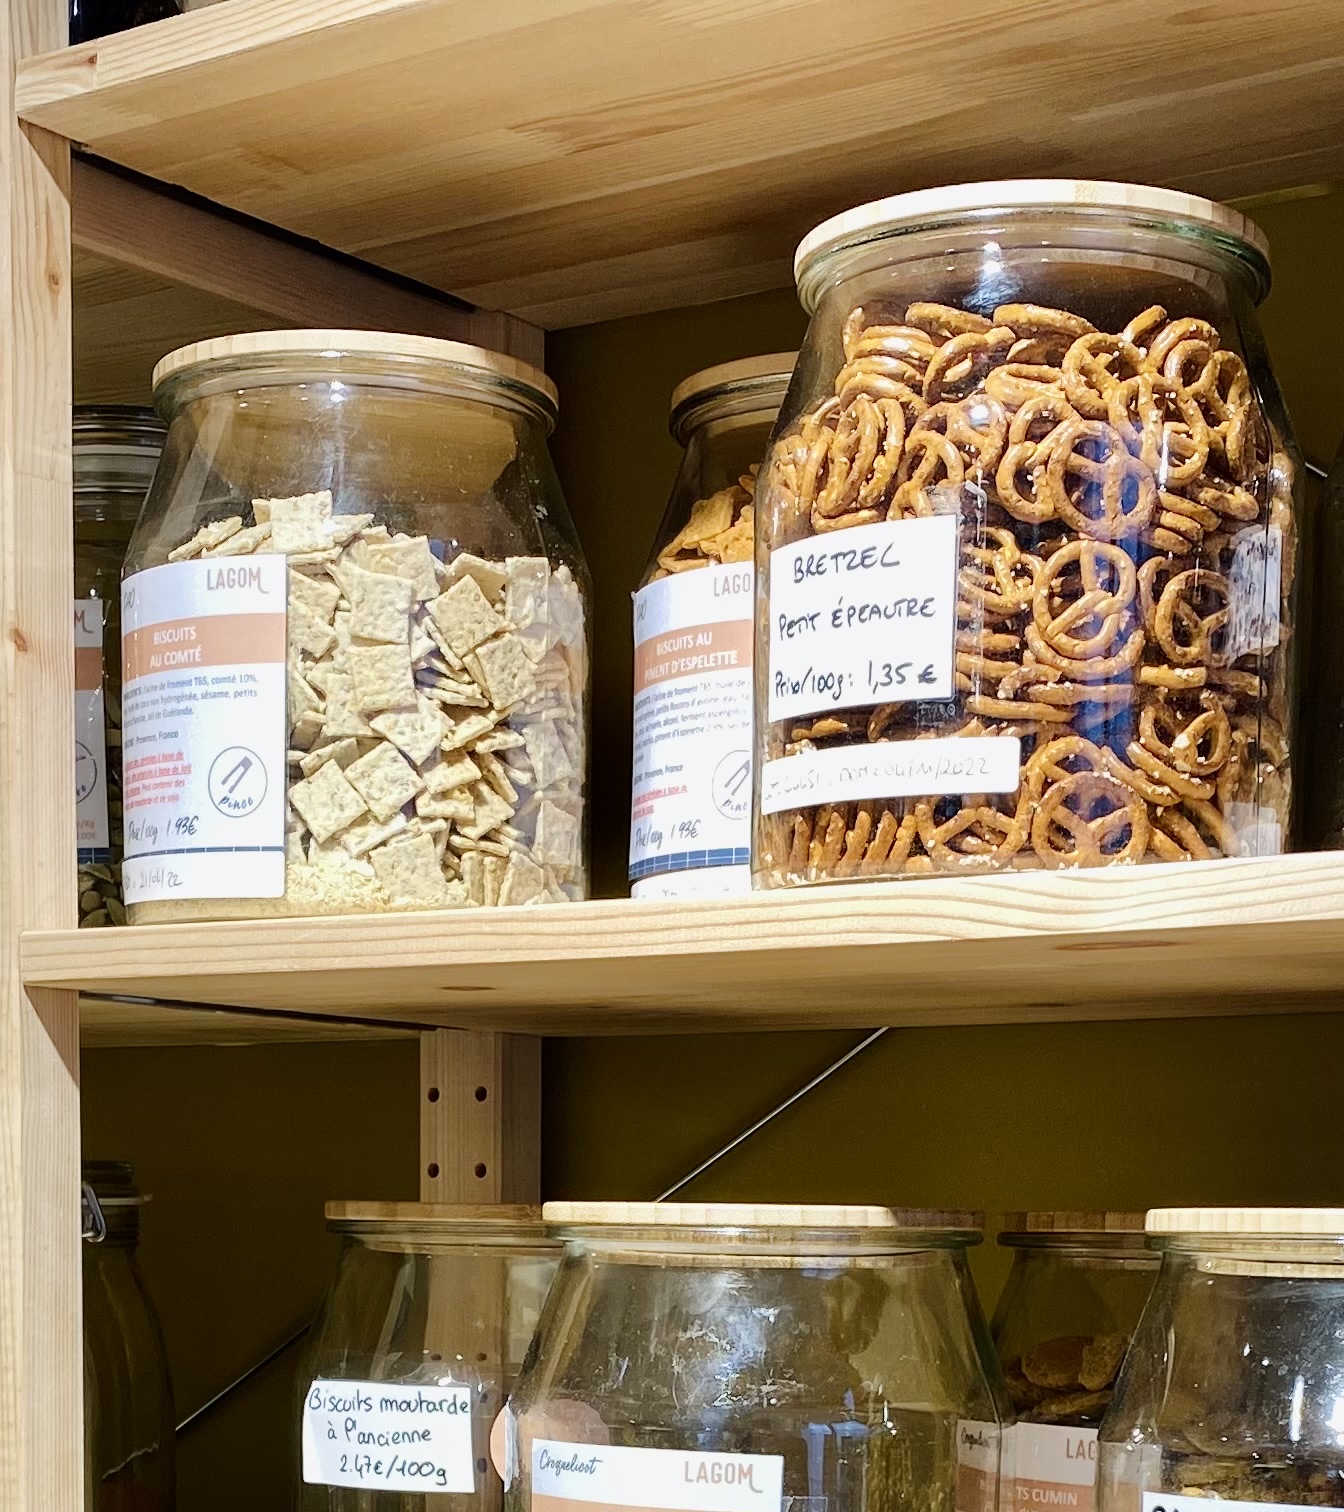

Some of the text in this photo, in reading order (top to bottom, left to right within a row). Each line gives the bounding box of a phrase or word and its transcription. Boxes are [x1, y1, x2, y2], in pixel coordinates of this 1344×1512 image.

[793, 543, 900, 584] BRETZEL
[207, 567, 269, 594] LAGOM
[779, 596, 935, 640] PETIT ÉPEAUTRE
[154, 626, 196, 646] BISCUITS
[657, 631, 712, 656] BISCUITS AU
[150, 645, 202, 668] AU COMTÉ
[867, 661, 912, 695] 1,35
[308, 1387, 469, 1415] Biscuits moutarde
[328, 1422, 337, 1440] à
[539, 1448, 763, 1494] Croquelicot LAGOM
[1032, 1489, 1078, 1506] CUMIN
